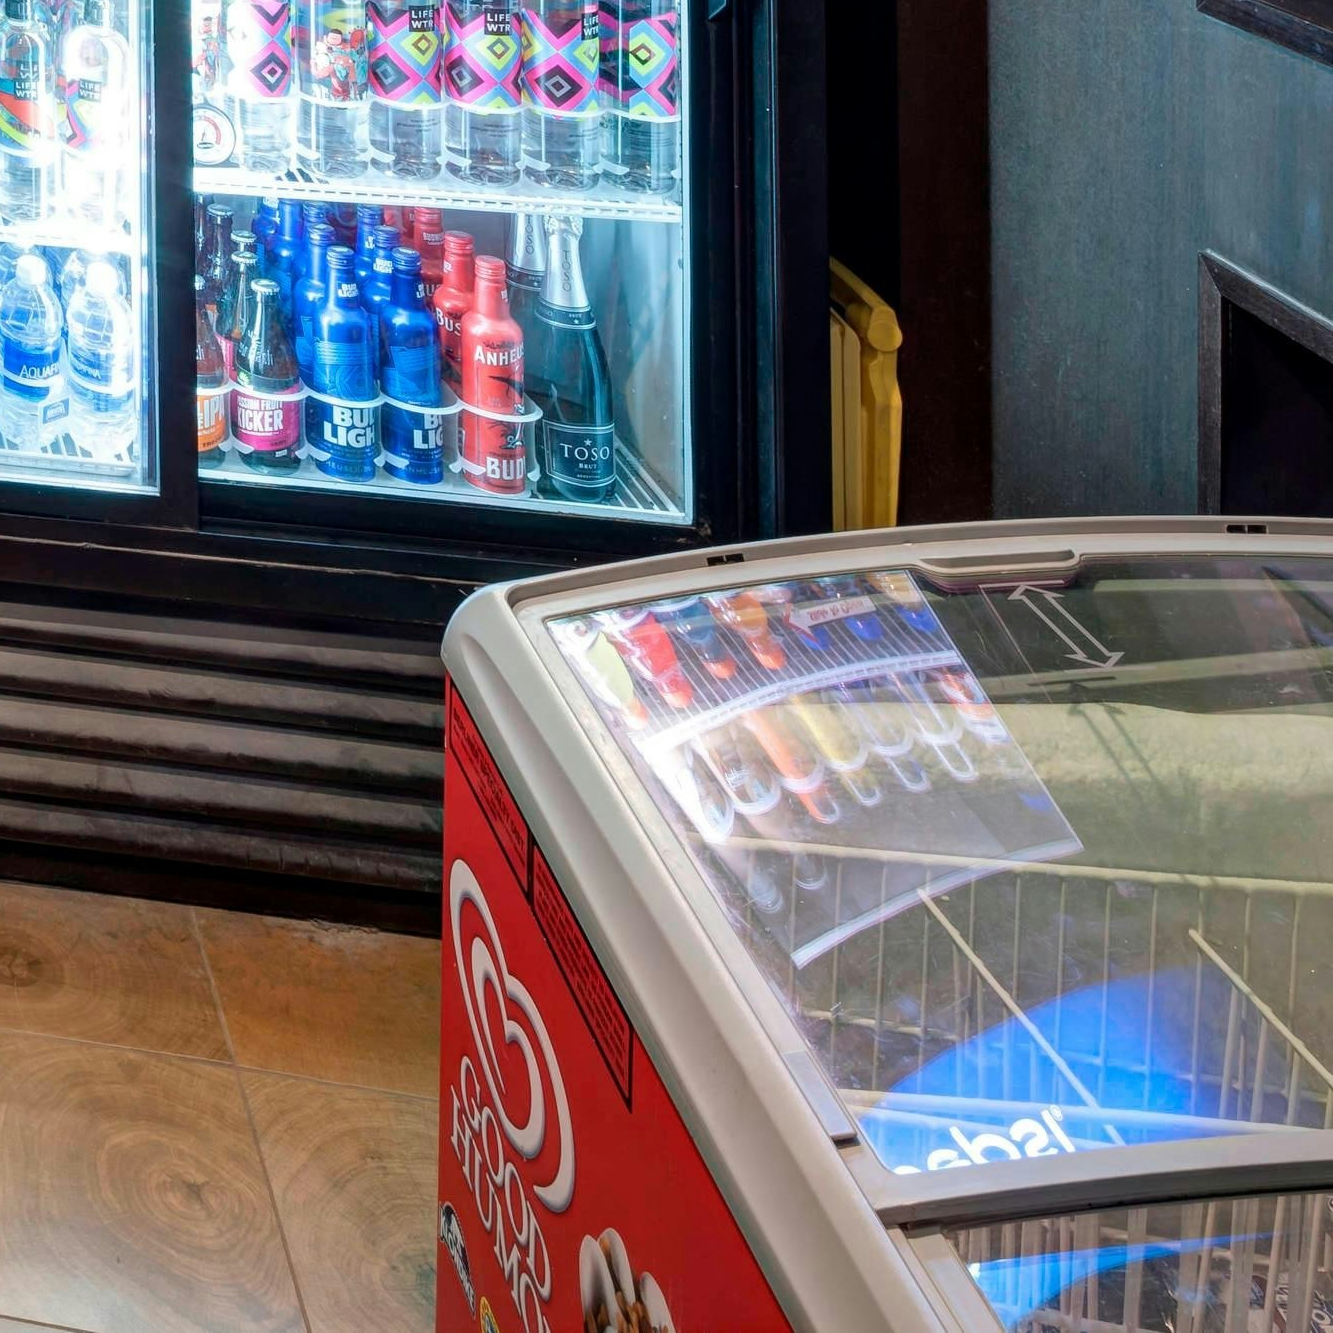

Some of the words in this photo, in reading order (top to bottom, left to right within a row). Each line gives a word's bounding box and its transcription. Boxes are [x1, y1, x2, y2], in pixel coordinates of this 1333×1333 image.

[411, 9, 434, 19] LIFE
[486, 12, 510, 22] LIFE
[411, 19, 434, 29] WTR
[486, 22, 510, 32] WTR
[561, 249, 572, 292] TOSO
[237, 409, 284, 431] KICKER
[558, 442, 611, 461] TOSO
[460, 1055, 551, 1301] GOOD
